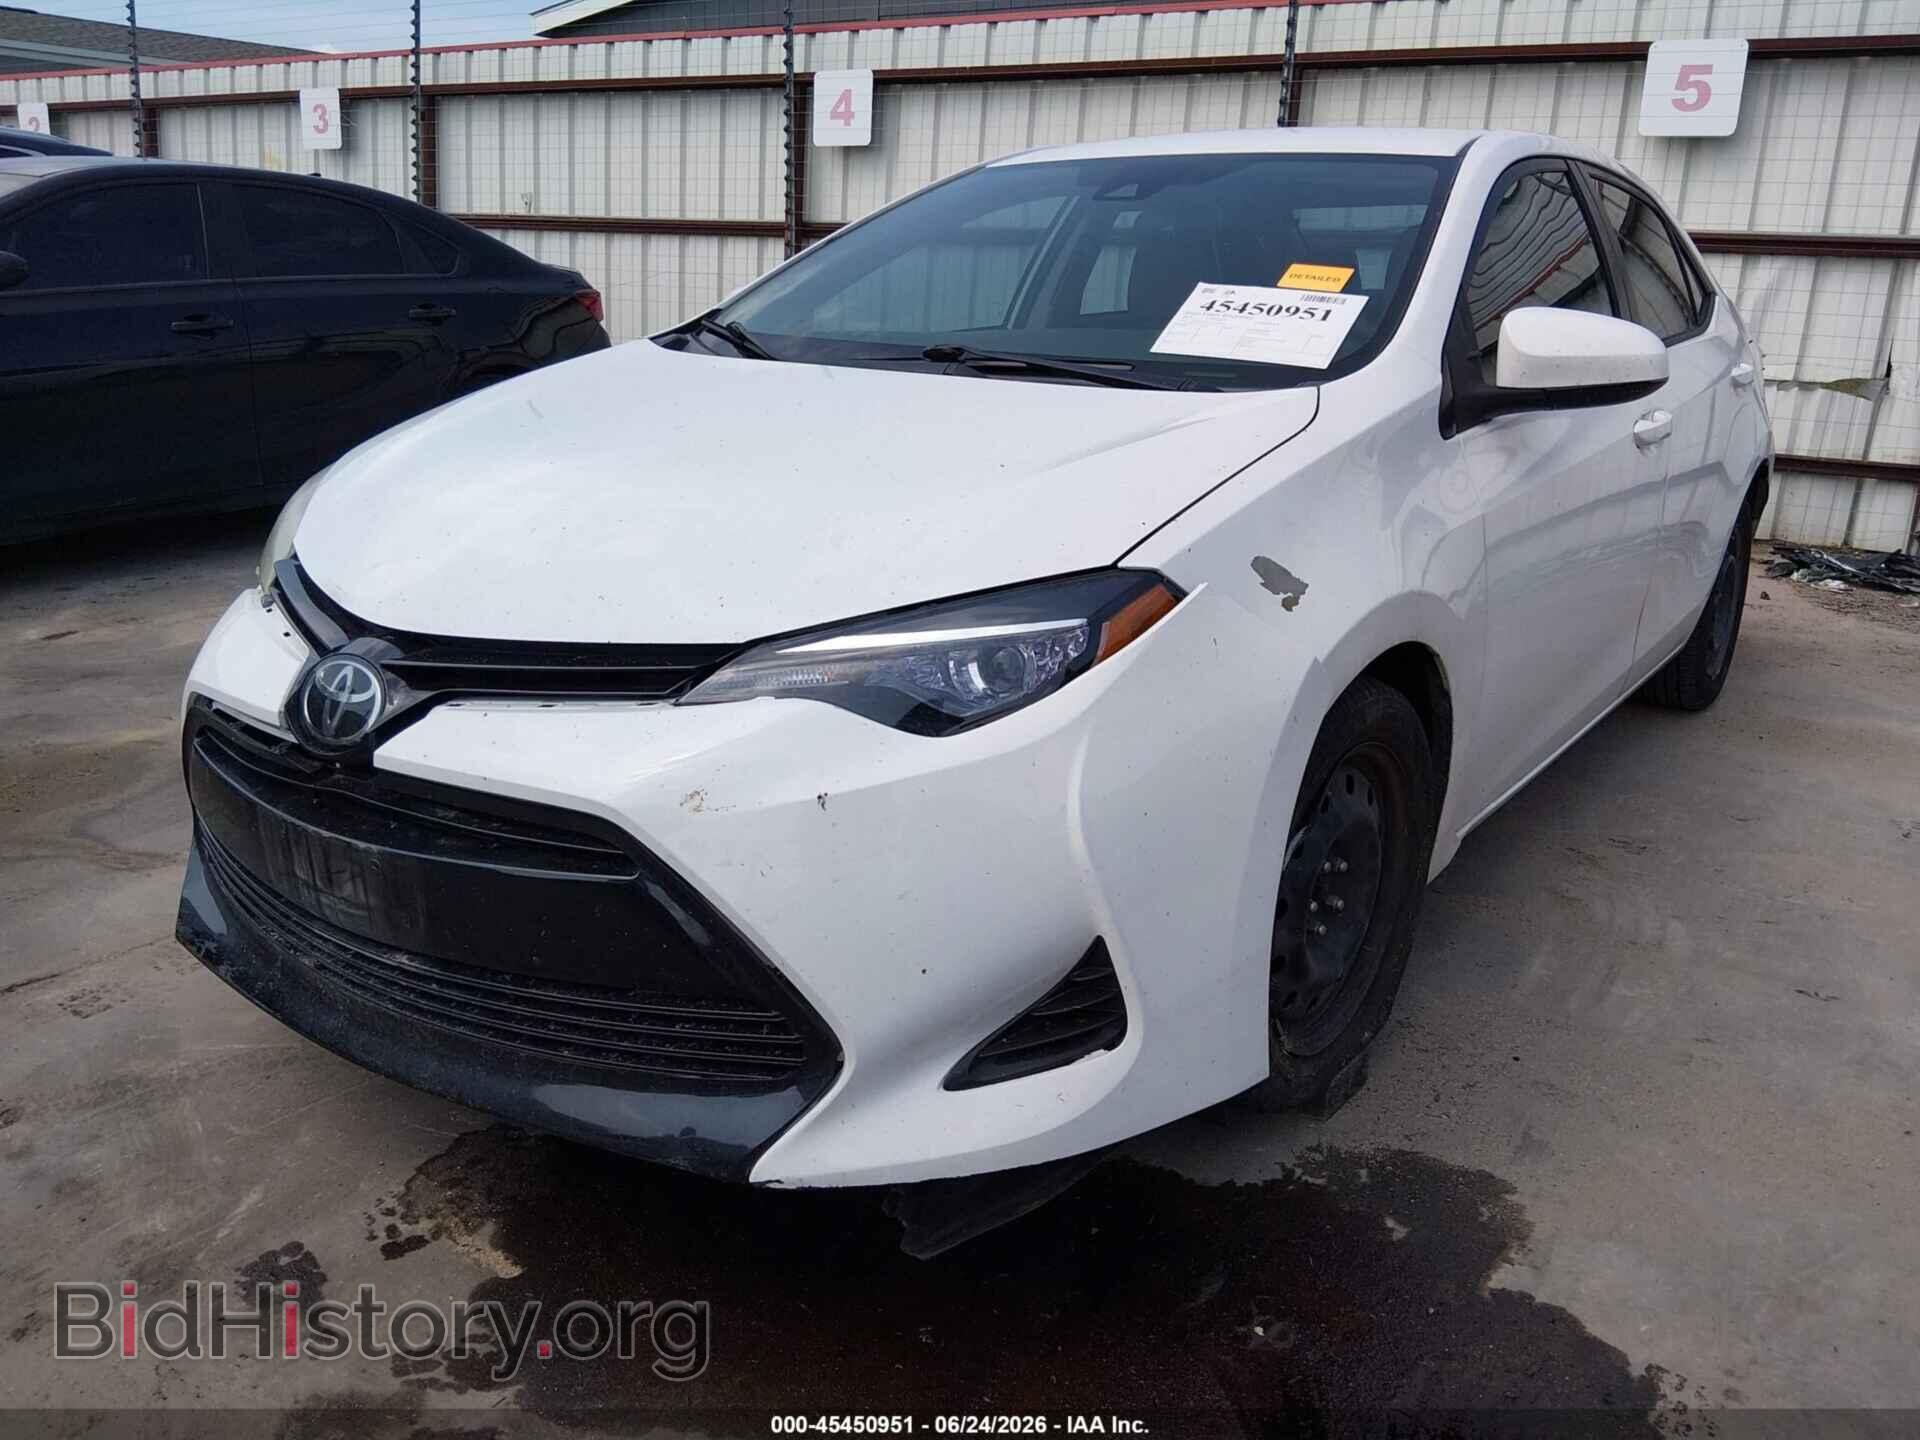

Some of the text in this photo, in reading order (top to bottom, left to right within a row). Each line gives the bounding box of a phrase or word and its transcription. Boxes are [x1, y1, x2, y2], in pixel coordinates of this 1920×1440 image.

[1672, 64, 1713, 112] 5
[313, 103, 329, 134] 3
[830, 89, 855, 126] 4
[1288, 272, 1341, 283] DETAILED
[1200, 299, 1333, 322] 45450951
